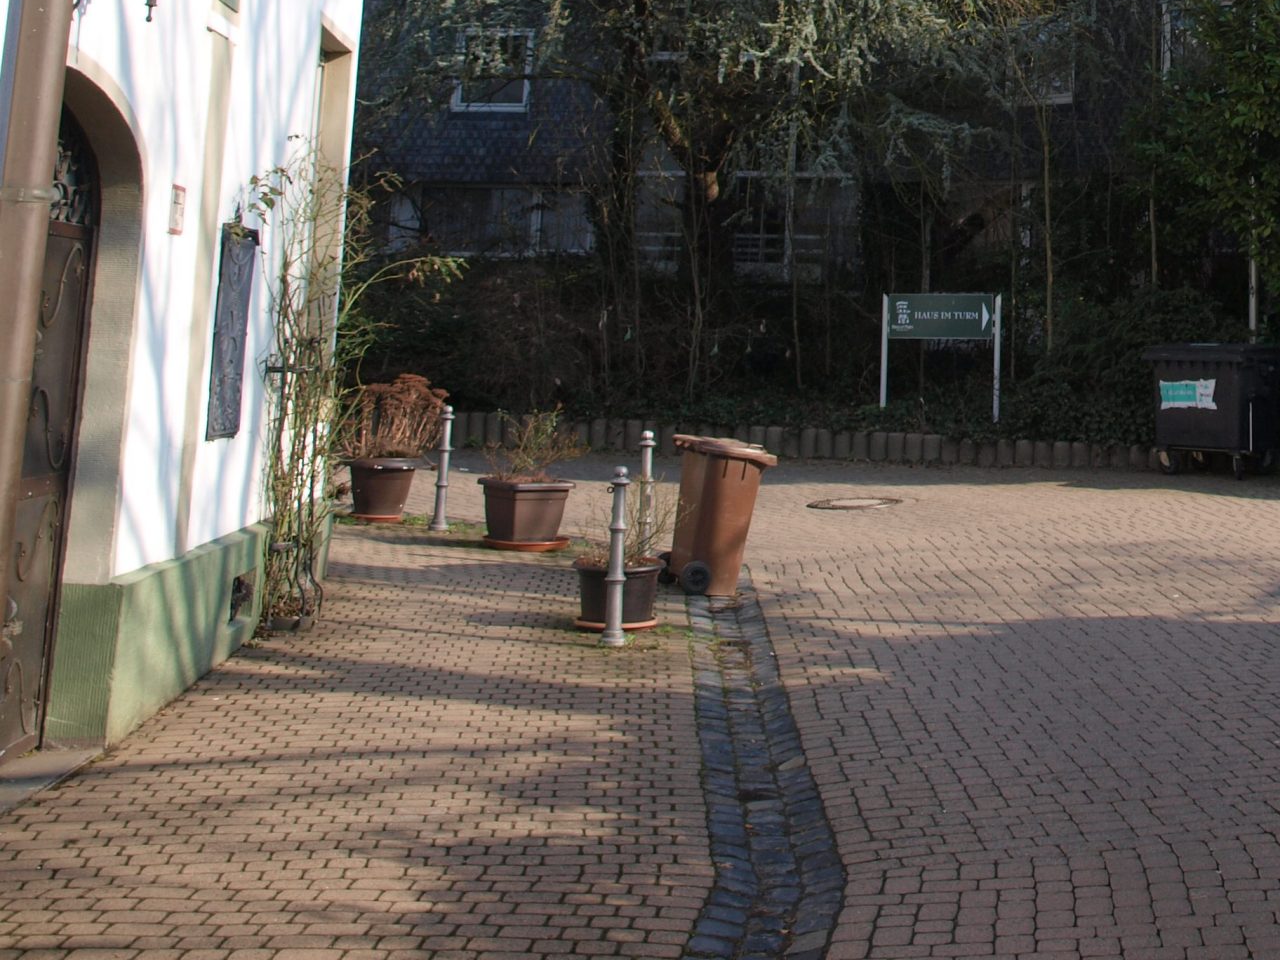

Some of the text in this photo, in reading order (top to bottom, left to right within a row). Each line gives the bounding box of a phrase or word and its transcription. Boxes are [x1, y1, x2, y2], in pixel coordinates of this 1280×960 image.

[914, 311, 978, 320] HAUS IM TURM
